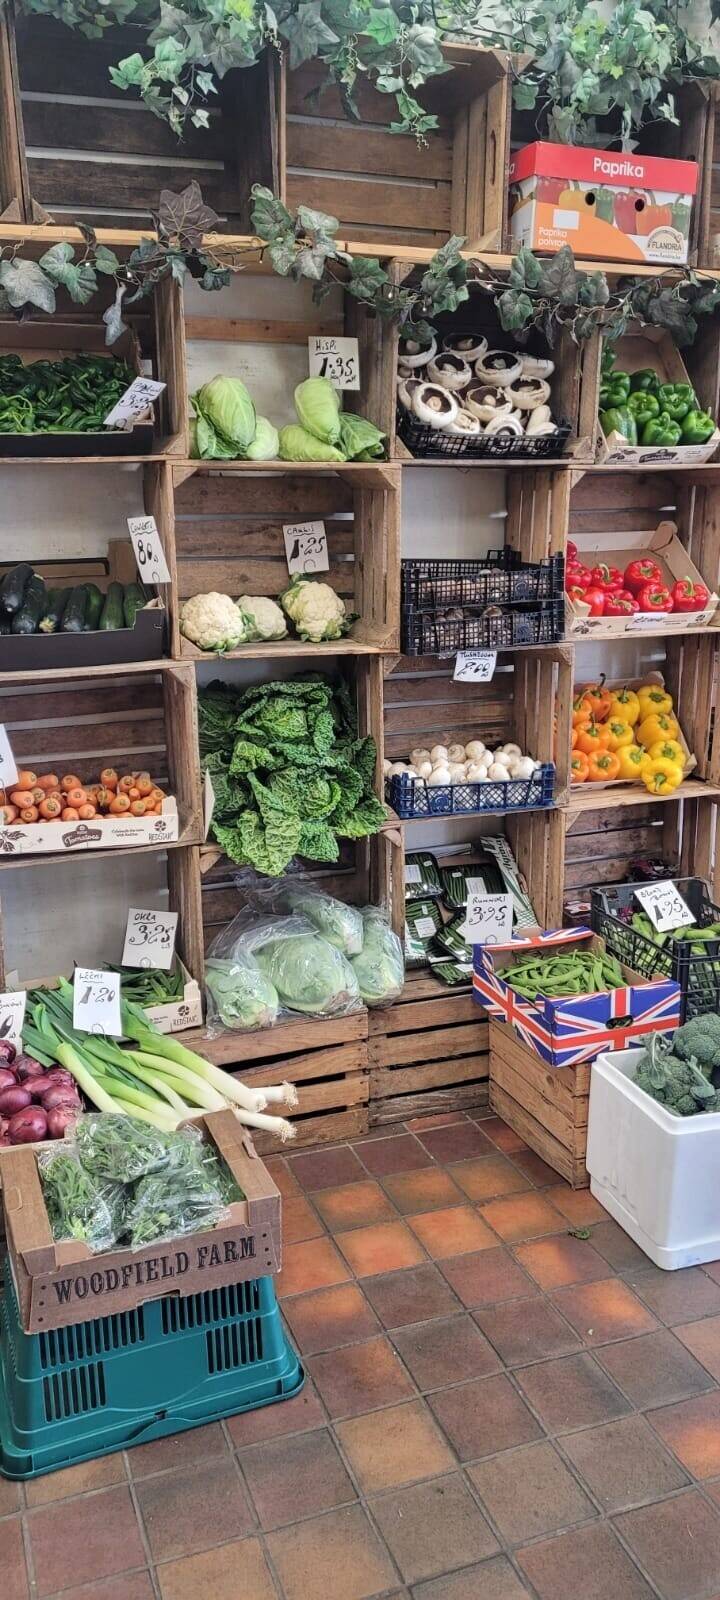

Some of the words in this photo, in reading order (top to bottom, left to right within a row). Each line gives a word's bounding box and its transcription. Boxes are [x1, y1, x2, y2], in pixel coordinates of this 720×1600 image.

[593, 157, 644, 178] Paprika
[539, 226, 568, 238] Paprika
[651, 241, 682, 251] FLANDRIA
[64, 834, 100, 847] Tomatoes
[52, 1251, 189, 1304] WOODFIELD
[197, 1235, 257, 1269] FARM
